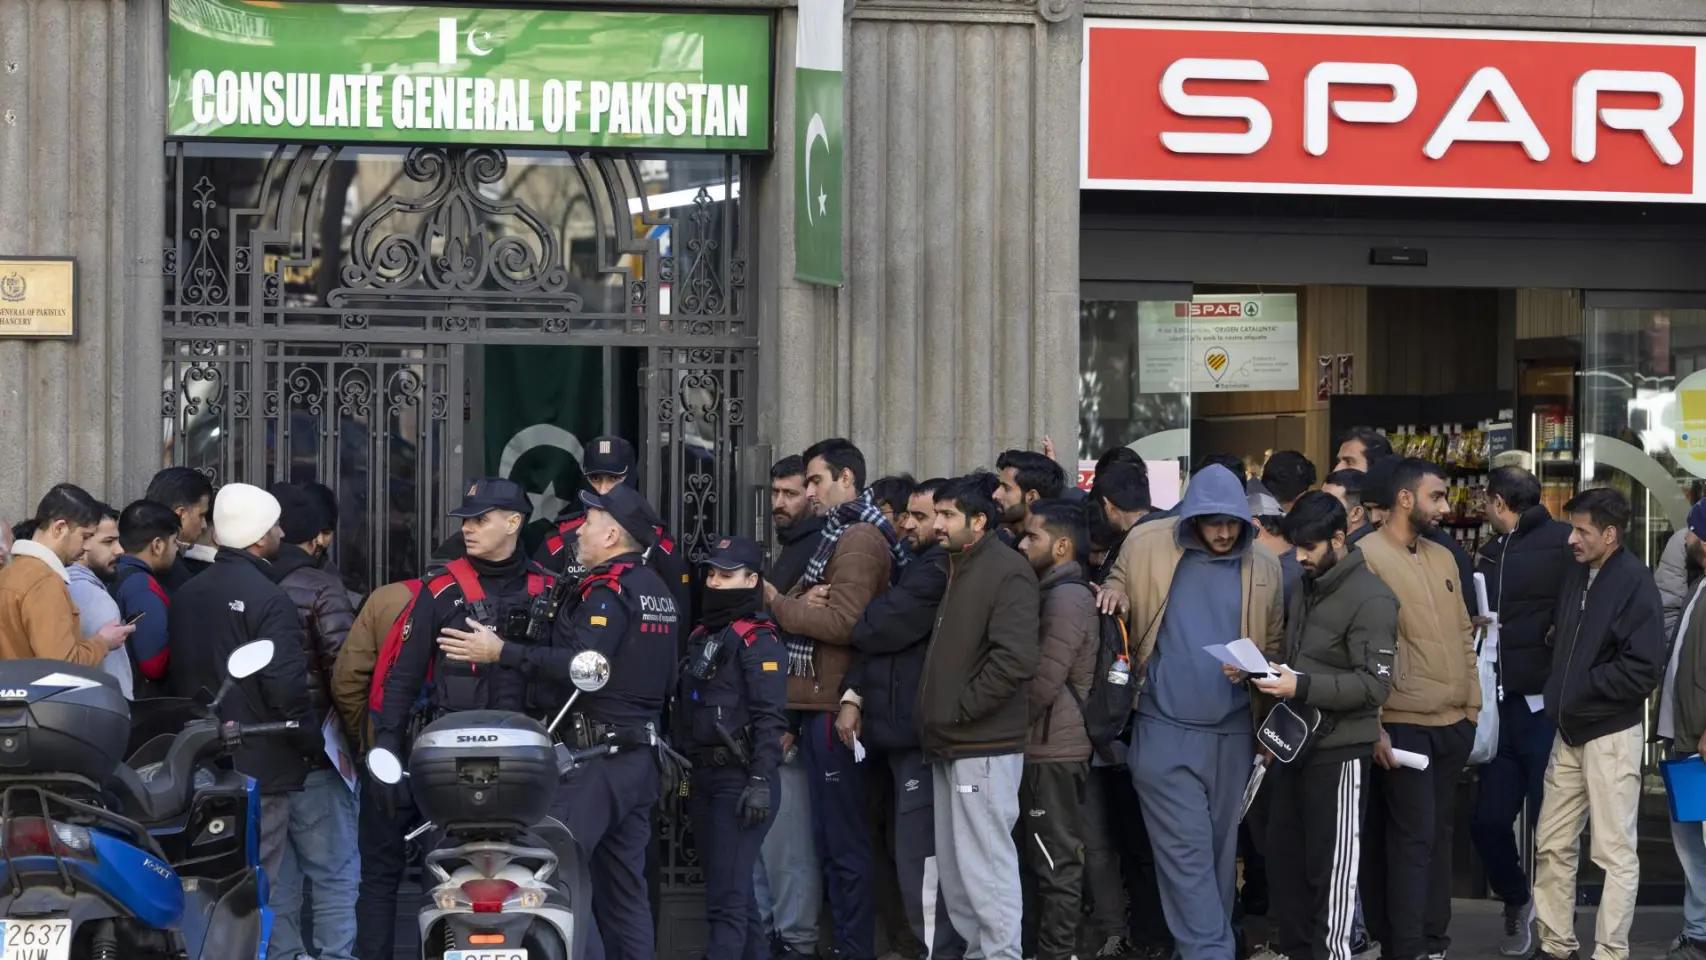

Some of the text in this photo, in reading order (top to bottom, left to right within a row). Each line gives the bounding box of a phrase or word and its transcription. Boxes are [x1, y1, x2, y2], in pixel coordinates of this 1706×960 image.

[192, 69, 749, 138] CONSULATE GENERAL OF PAKISTAN
[1159, 58, 1684, 166] SPAR
[36, 308, 66, 317] PAKISTAN
[1190, 304, 1240, 316] SPAR
[0, 689, 28, 697] HAD
[457, 735, 498, 743] SHAD
[1263, 728, 1285, 748] adidas
[8, 924, 67, 946] 2637
